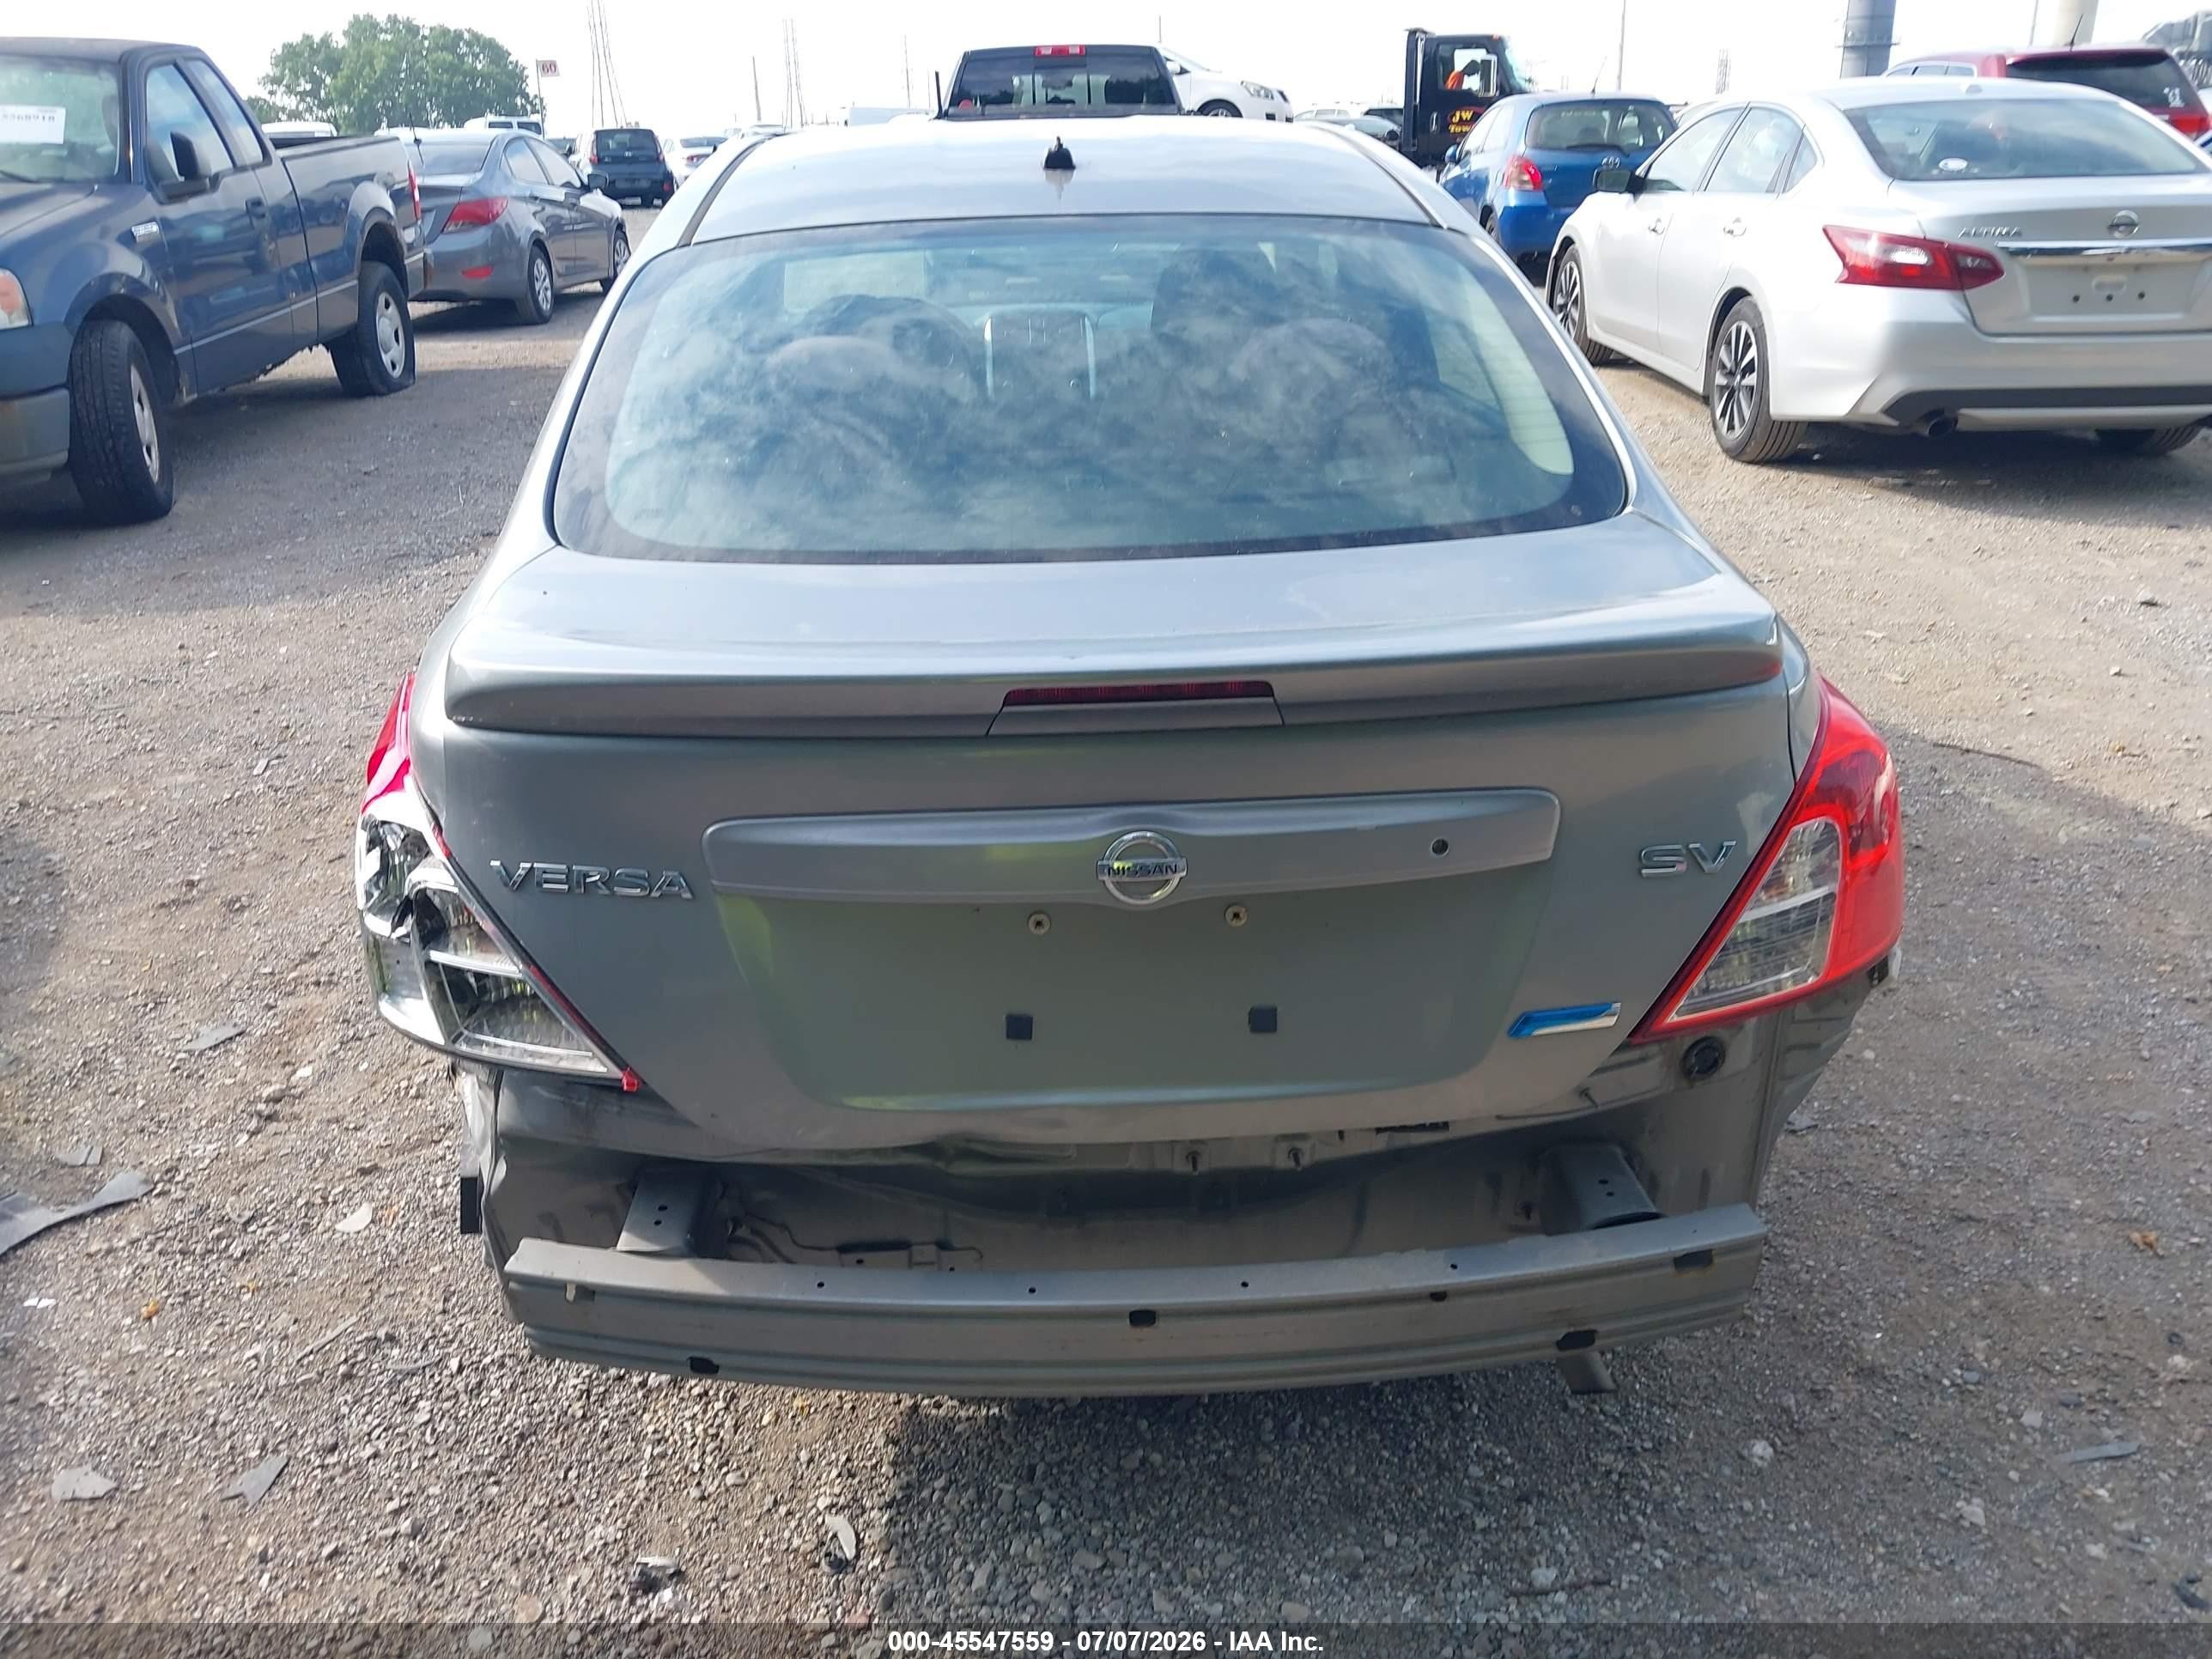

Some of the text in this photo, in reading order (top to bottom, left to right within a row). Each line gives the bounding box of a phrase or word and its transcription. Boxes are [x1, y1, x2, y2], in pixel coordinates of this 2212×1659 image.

[542, 63, 556, 73] 60
[1452, 110, 1474, 123] JW
[1641, 841, 1736, 878] SV
[1106, 863, 1177, 878] NISSAN
[489, 860, 693, 899] VERSA
